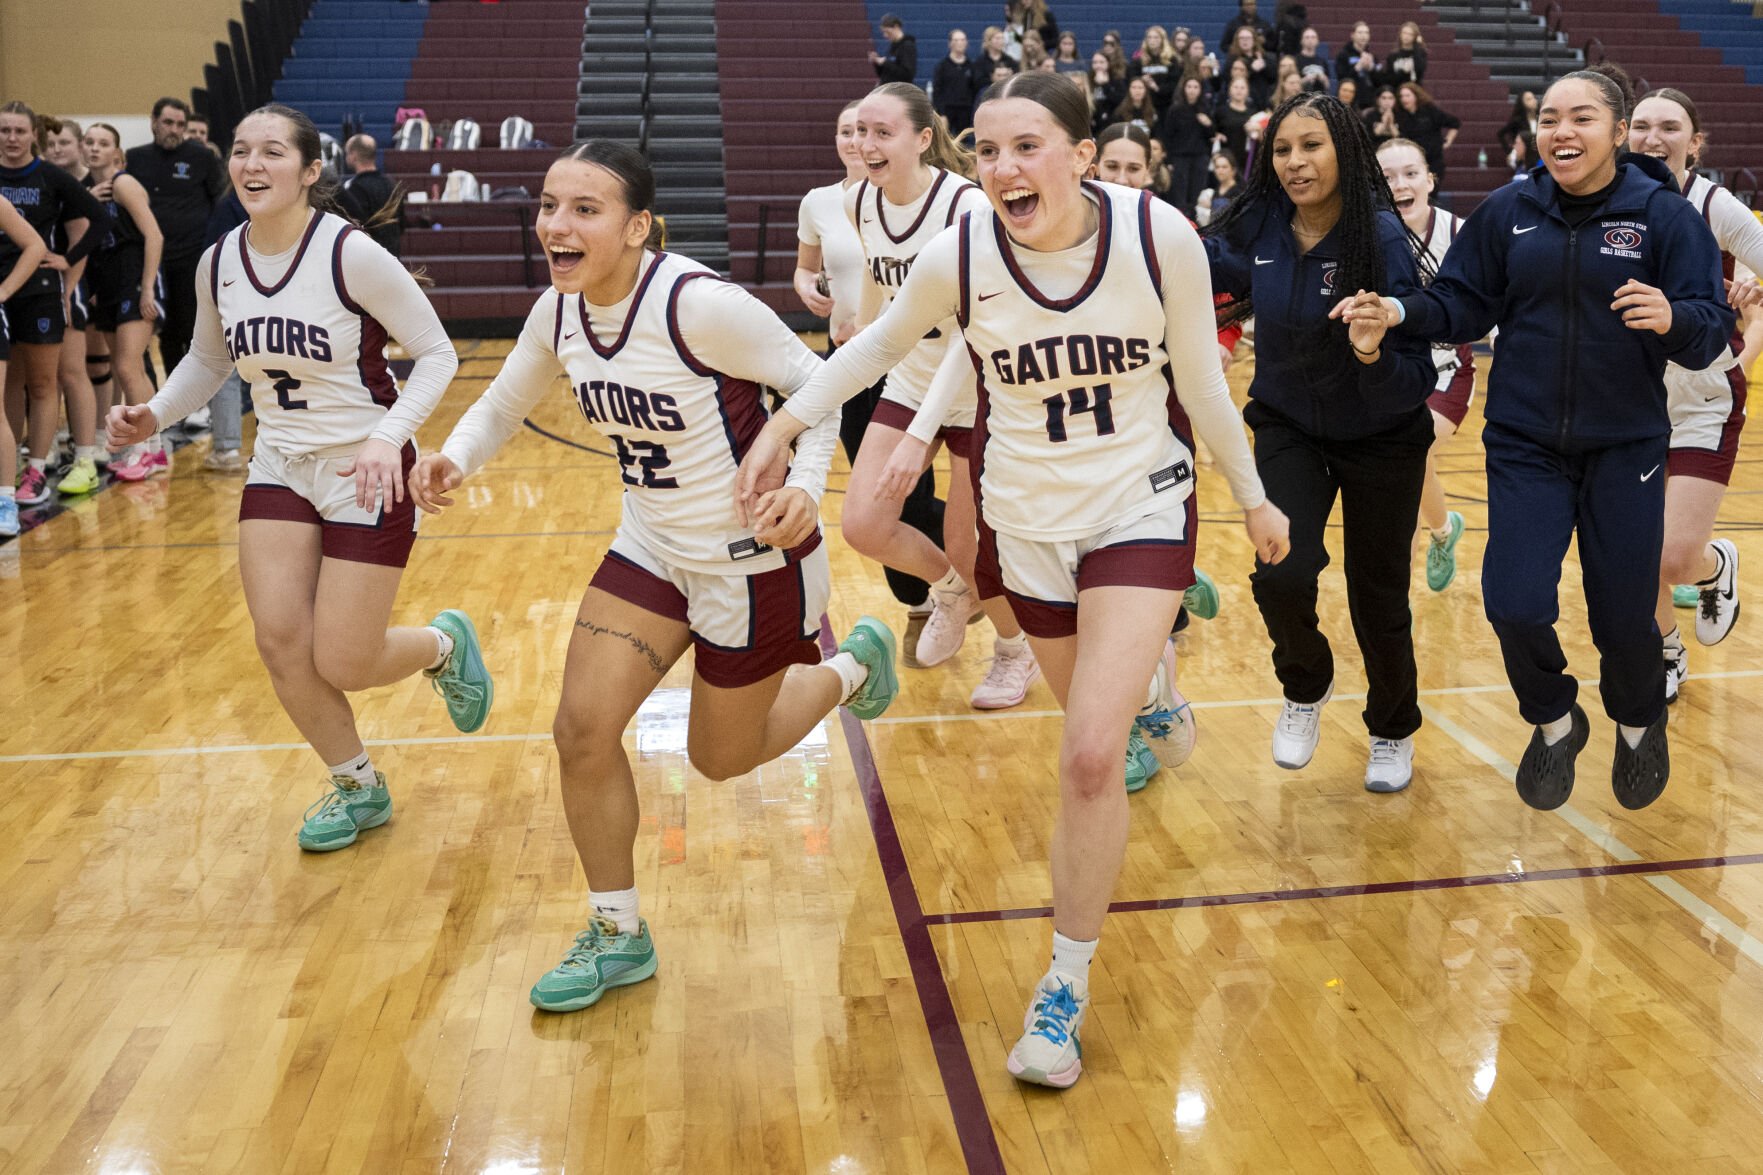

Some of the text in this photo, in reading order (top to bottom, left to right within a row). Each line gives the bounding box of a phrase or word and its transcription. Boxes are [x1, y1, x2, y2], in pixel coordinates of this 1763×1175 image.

[0, 186, 41, 206] TIAN
[990, 334, 1150, 385] GATORS
[262, 368, 309, 411] 2
[1042, 383, 1116, 443] 14
